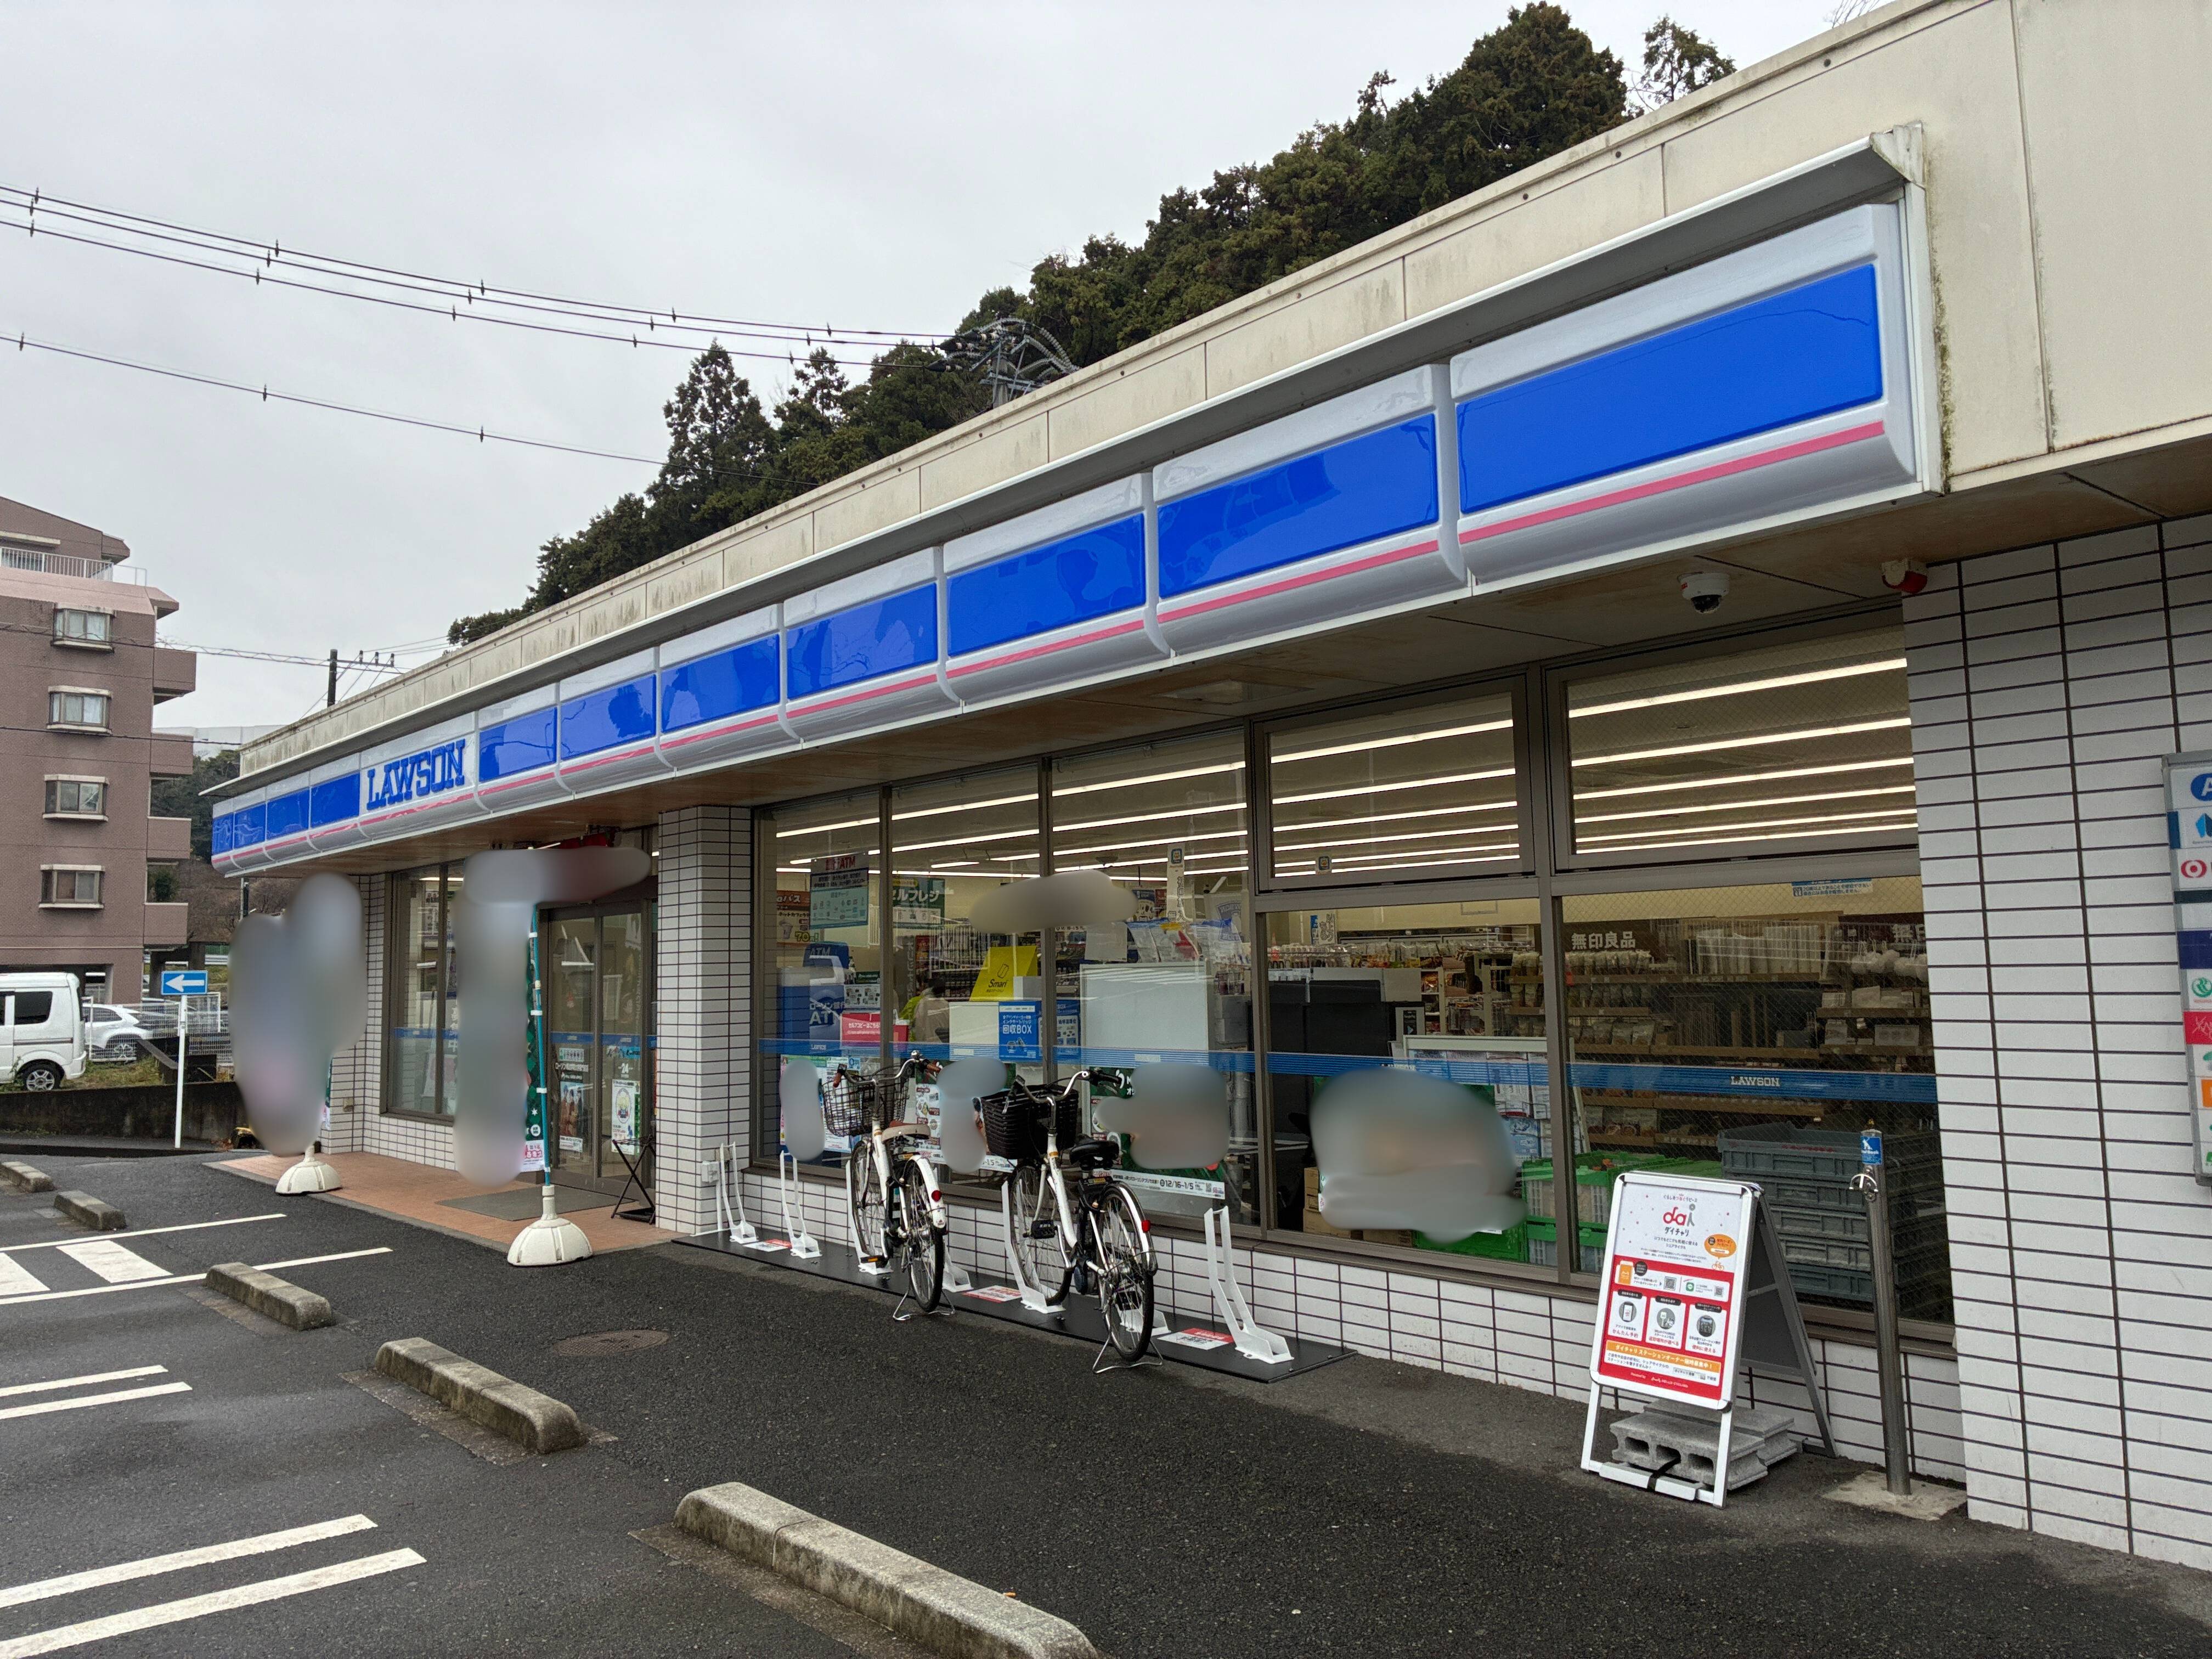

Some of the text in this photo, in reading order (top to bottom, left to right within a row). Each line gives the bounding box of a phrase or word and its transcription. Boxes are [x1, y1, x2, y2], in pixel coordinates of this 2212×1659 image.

[366, 738, 465, 810] LAWSON
[1571, 931, 1635, 950] 無印良品
[1002, 1024, 1032, 1034] 回収BOX
[1730, 1076, 1780, 1087] LAWSON
[1664, 1226, 1690, 1237] ダイチャリ
